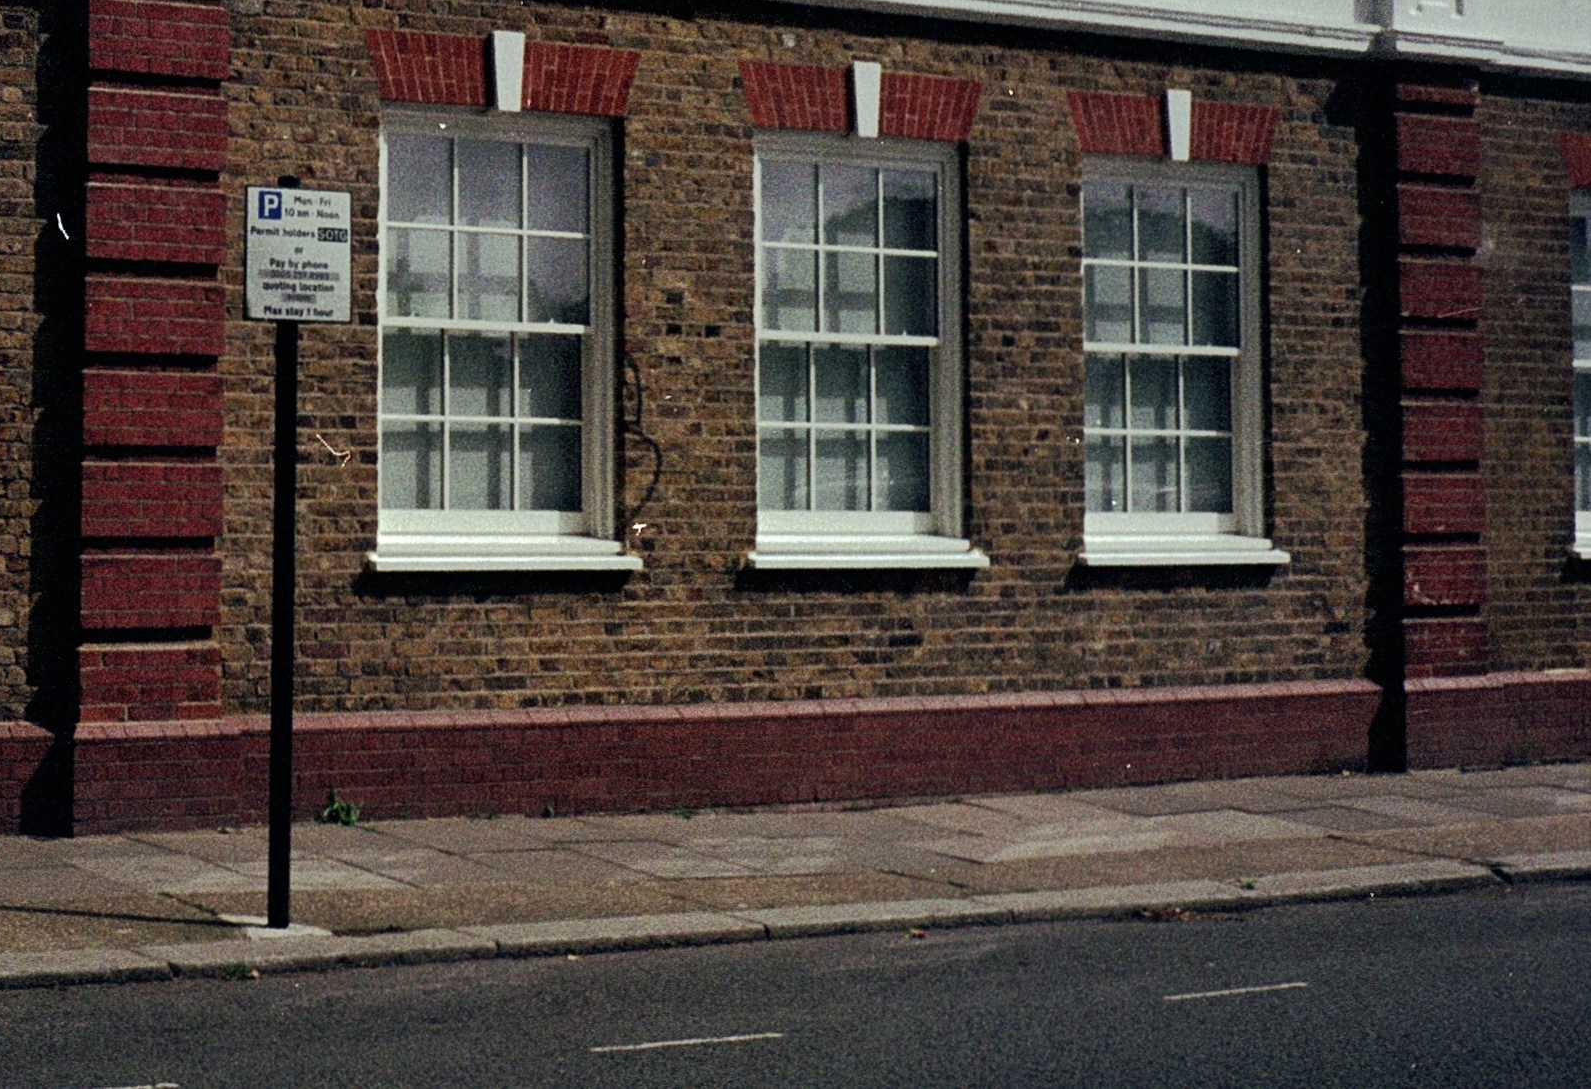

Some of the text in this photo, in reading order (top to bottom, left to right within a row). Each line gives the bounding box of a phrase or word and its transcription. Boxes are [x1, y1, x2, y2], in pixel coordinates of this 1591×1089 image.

[263, 193, 280, 218] P
[293, 196, 312, 206] Mon
[319, 197, 332, 207] Fri
[285, 207, 295, 217] 10
[316, 209, 340, 219] Noon
[250, 225, 280, 236] Permit
[282, 227, 316, 238] holders
[269, 257, 329, 270] Pay by phone
[299, 281, 335, 292] location
[263, 305, 283, 315] Max
[285, 307, 305, 317] stay
[312, 308, 334, 318] hour
